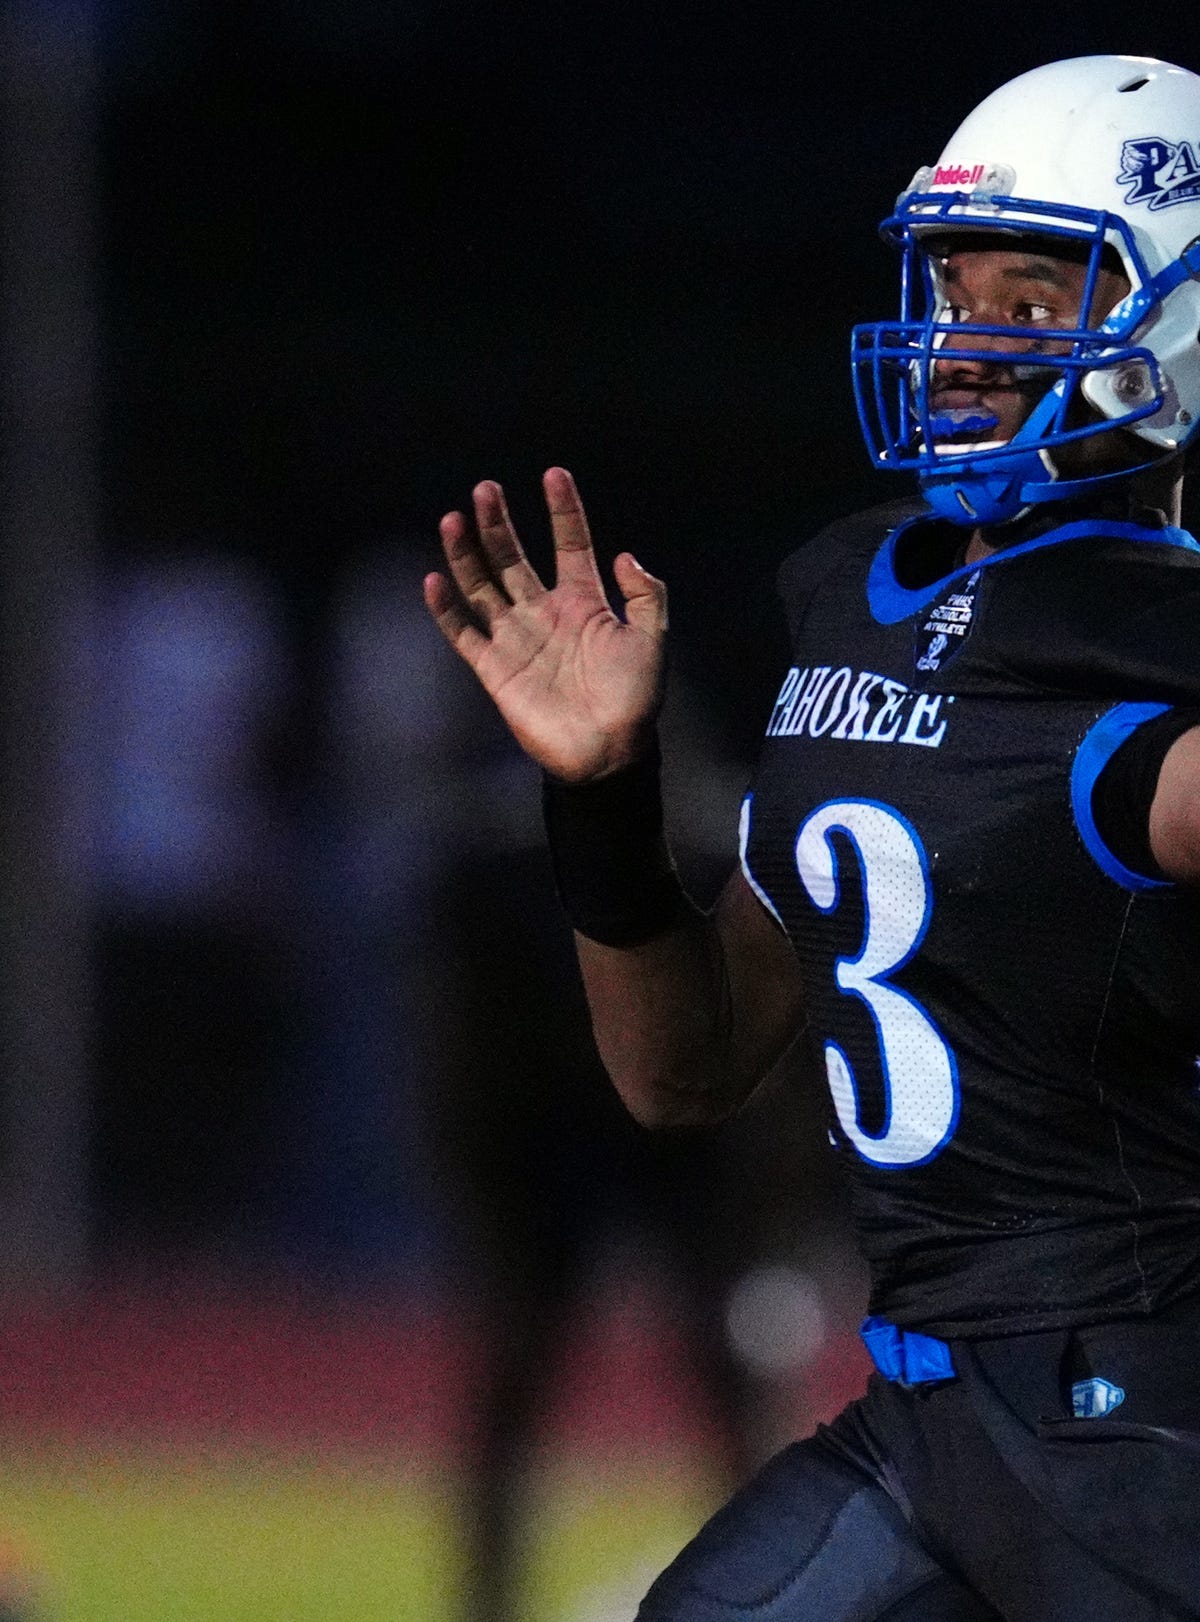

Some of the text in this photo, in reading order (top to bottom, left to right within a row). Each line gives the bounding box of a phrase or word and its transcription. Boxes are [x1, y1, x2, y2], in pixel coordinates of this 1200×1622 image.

[923, 621, 967, 636] ATHLETE
[765, 666, 955, 748] PAHOKEE
[740, 791, 960, 1170] 3
